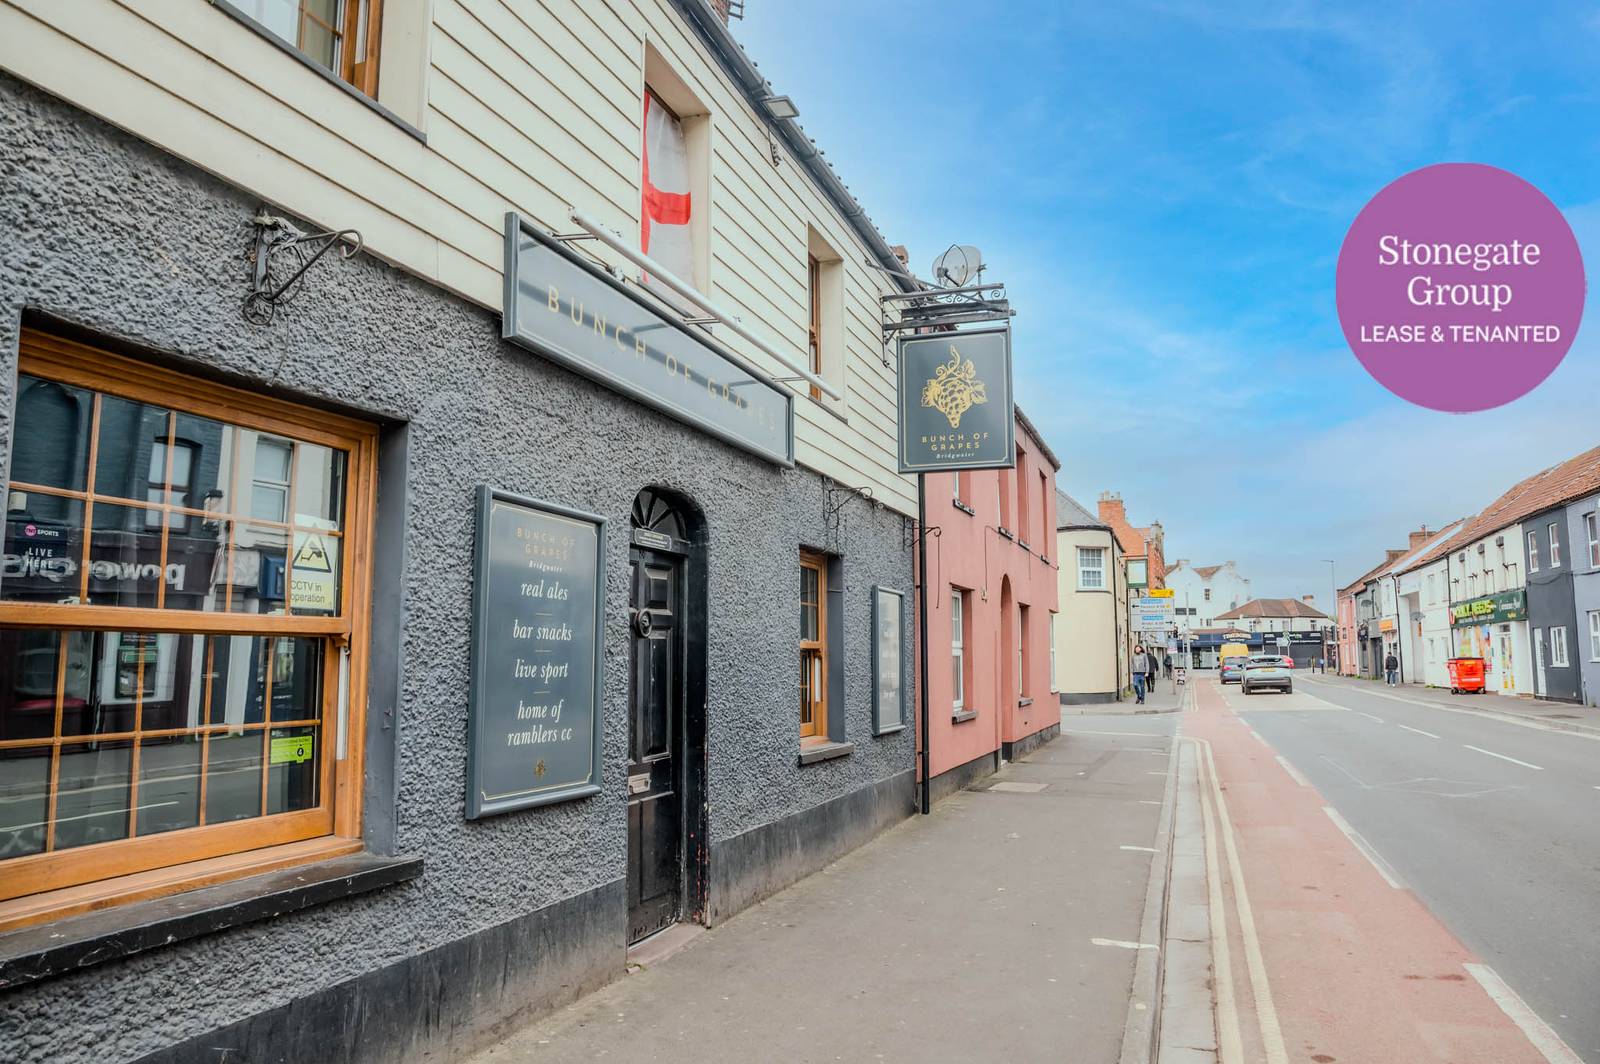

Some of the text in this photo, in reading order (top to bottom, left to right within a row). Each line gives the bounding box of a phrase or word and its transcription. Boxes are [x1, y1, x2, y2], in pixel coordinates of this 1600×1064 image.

[547, 284, 647, 363] BUNCH
[664, 353, 692, 385] OF
[922, 432, 989, 443] BUNCH OF
[931, 441, 980, 451] GRAPES
[37, 529, 60, 537] SPORTS
[517, 527, 556, 545] BUNCH
[28, 547, 53, 558] LIVE
[26, 557, 53, 569] HERE
[291, 580, 322, 593] CCTV in
[520, 579, 569, 601] real ales
[291, 593, 325, 604] operation
[513, 618, 573, 641] bar snacks
[514, 658, 569, 685] live sport
[517, 698, 565, 723] home of
[507, 724, 573, 747] ramblers cc
